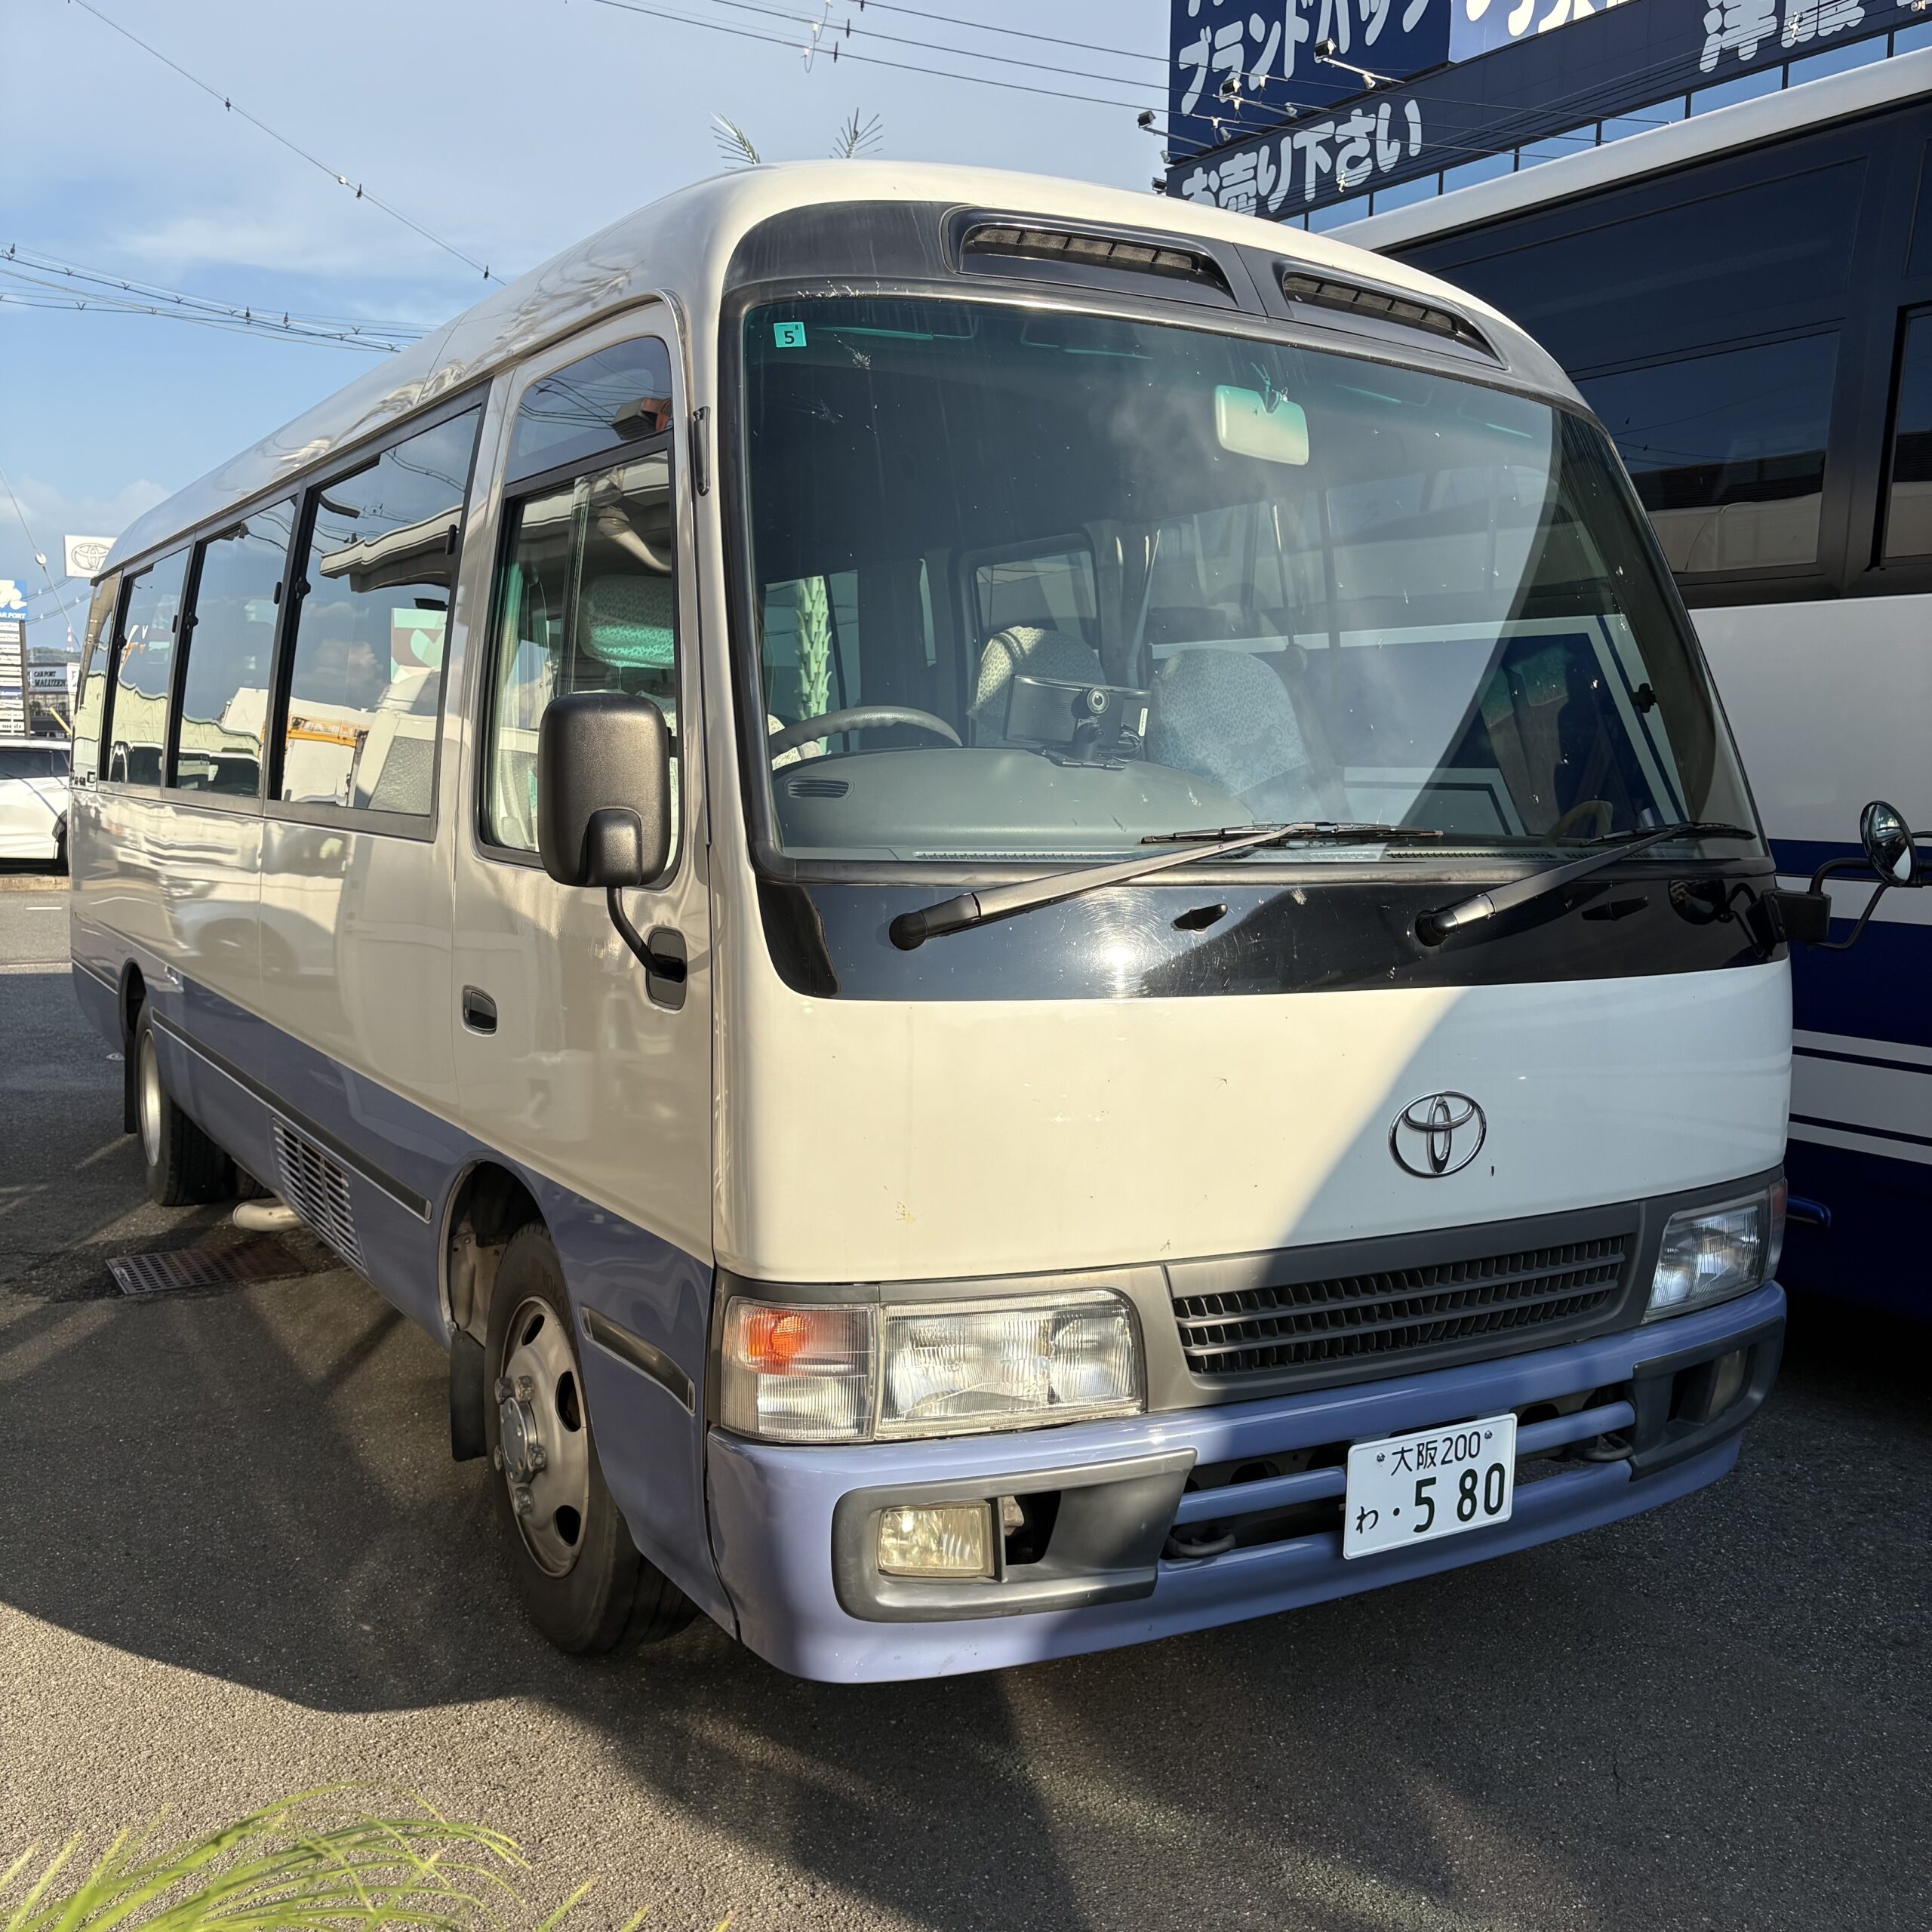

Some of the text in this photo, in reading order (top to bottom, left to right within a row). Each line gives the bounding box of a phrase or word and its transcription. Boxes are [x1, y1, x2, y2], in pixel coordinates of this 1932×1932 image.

[1182, 99, 1423, 217] お売り下さい
[784, 331, 795, 344] 5
[1355, 1506, 1379, 1534] わ
